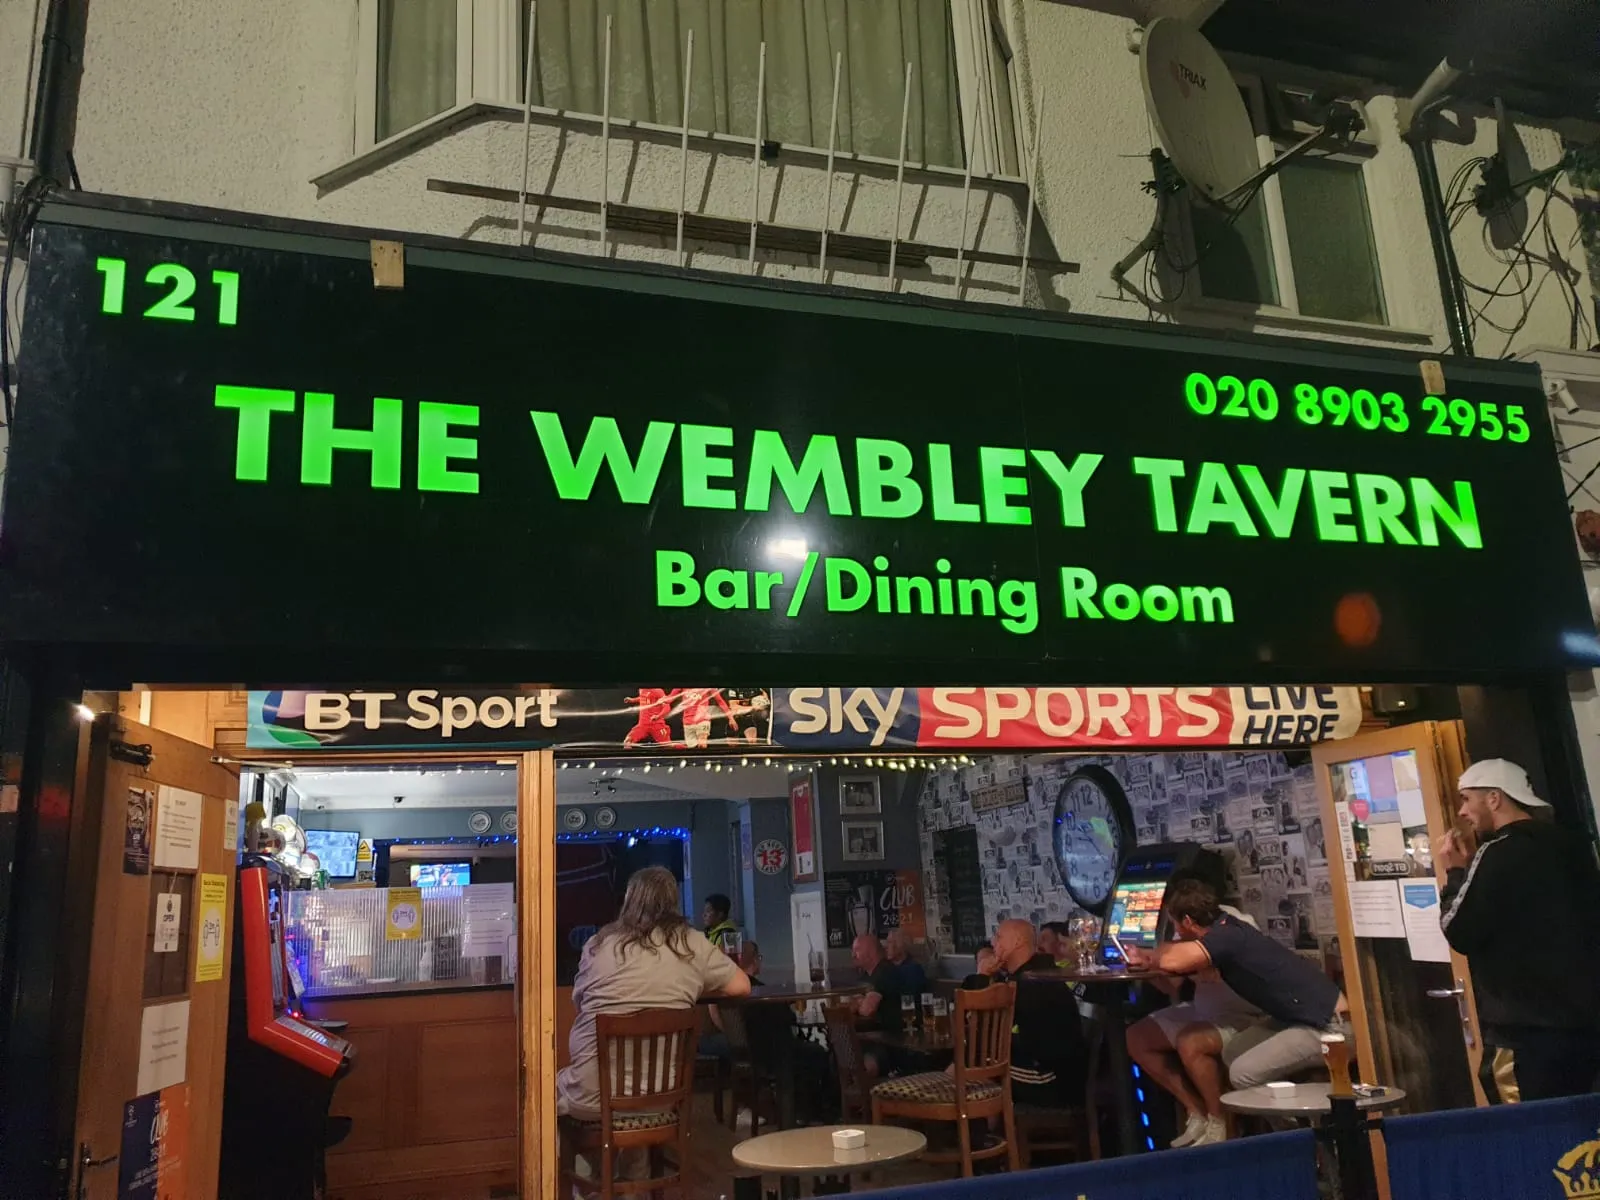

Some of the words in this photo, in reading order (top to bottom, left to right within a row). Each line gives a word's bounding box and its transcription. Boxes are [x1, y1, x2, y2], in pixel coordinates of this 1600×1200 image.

[1178, 63, 1207, 90] TRIAX
[96, 256, 239, 326] 121
[1184, 372, 1279, 422] 020
[1293, 382, 1410, 433] 8903
[1421, 395, 1531, 444] 2955
[214, 384, 481, 494] THE
[529, 410, 1104, 528] WEMBLEY
[1132, 456, 1484, 549] TAVERN
[655, 549, 1039, 635] Bar/Dining
[1060, 566, 1235, 623] Room
[304, 692, 397, 730] BT
[406, 689, 558, 737] Sport
[932, 687, 1220, 739] SPORTS
[1243, 687, 1338, 710] LIVE
[1242, 714, 1340, 745] HERE
[1071, 791, 1081, 812] 11
[1080, 784, 1093, 805] 12
[760, 849, 782, 866] 13
[879, 884, 915, 911] CLUB
